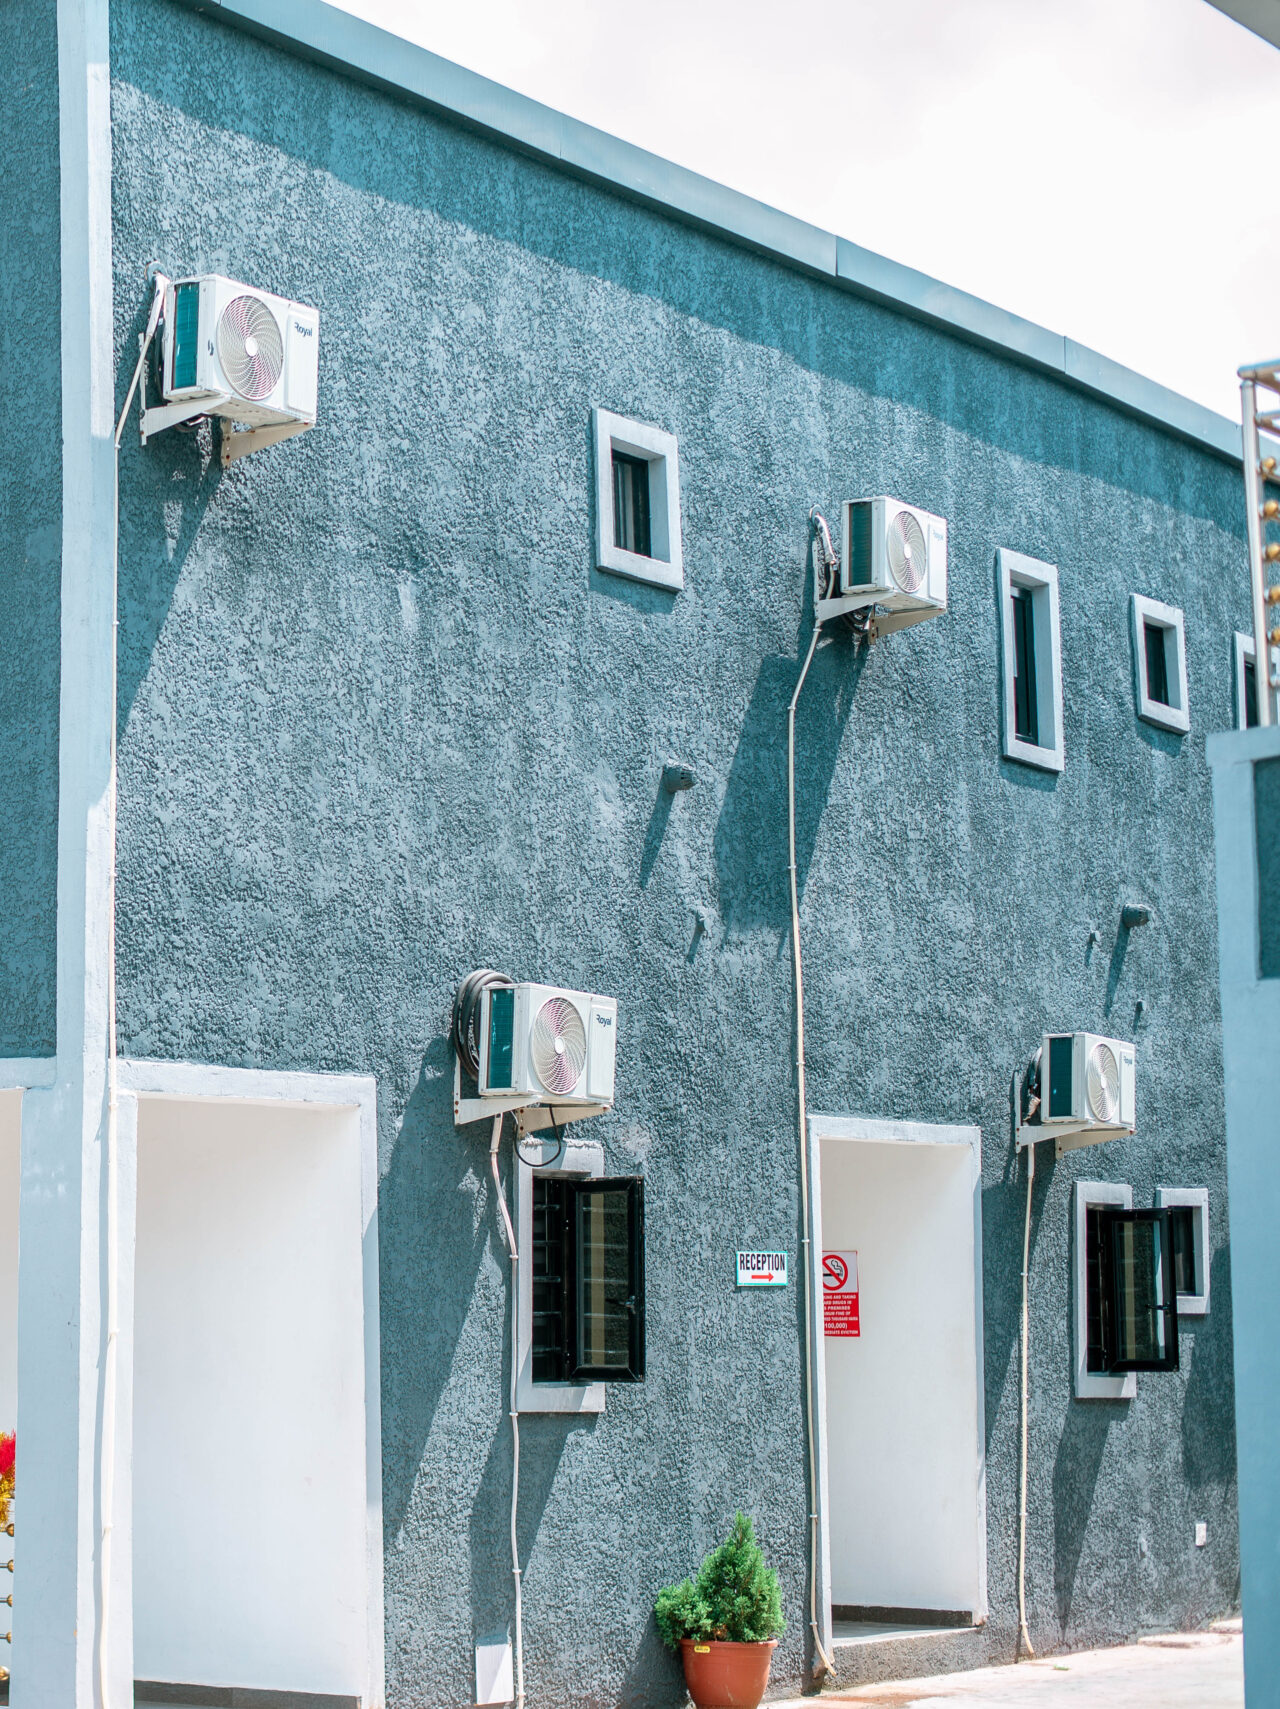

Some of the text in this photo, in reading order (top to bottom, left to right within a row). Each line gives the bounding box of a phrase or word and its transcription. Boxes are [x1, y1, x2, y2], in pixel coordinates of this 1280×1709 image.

[294, 322, 312, 338] Royal
[596, 1013, 612, 1028] Royal
[739, 1253, 785, 1271] RECEPTION
